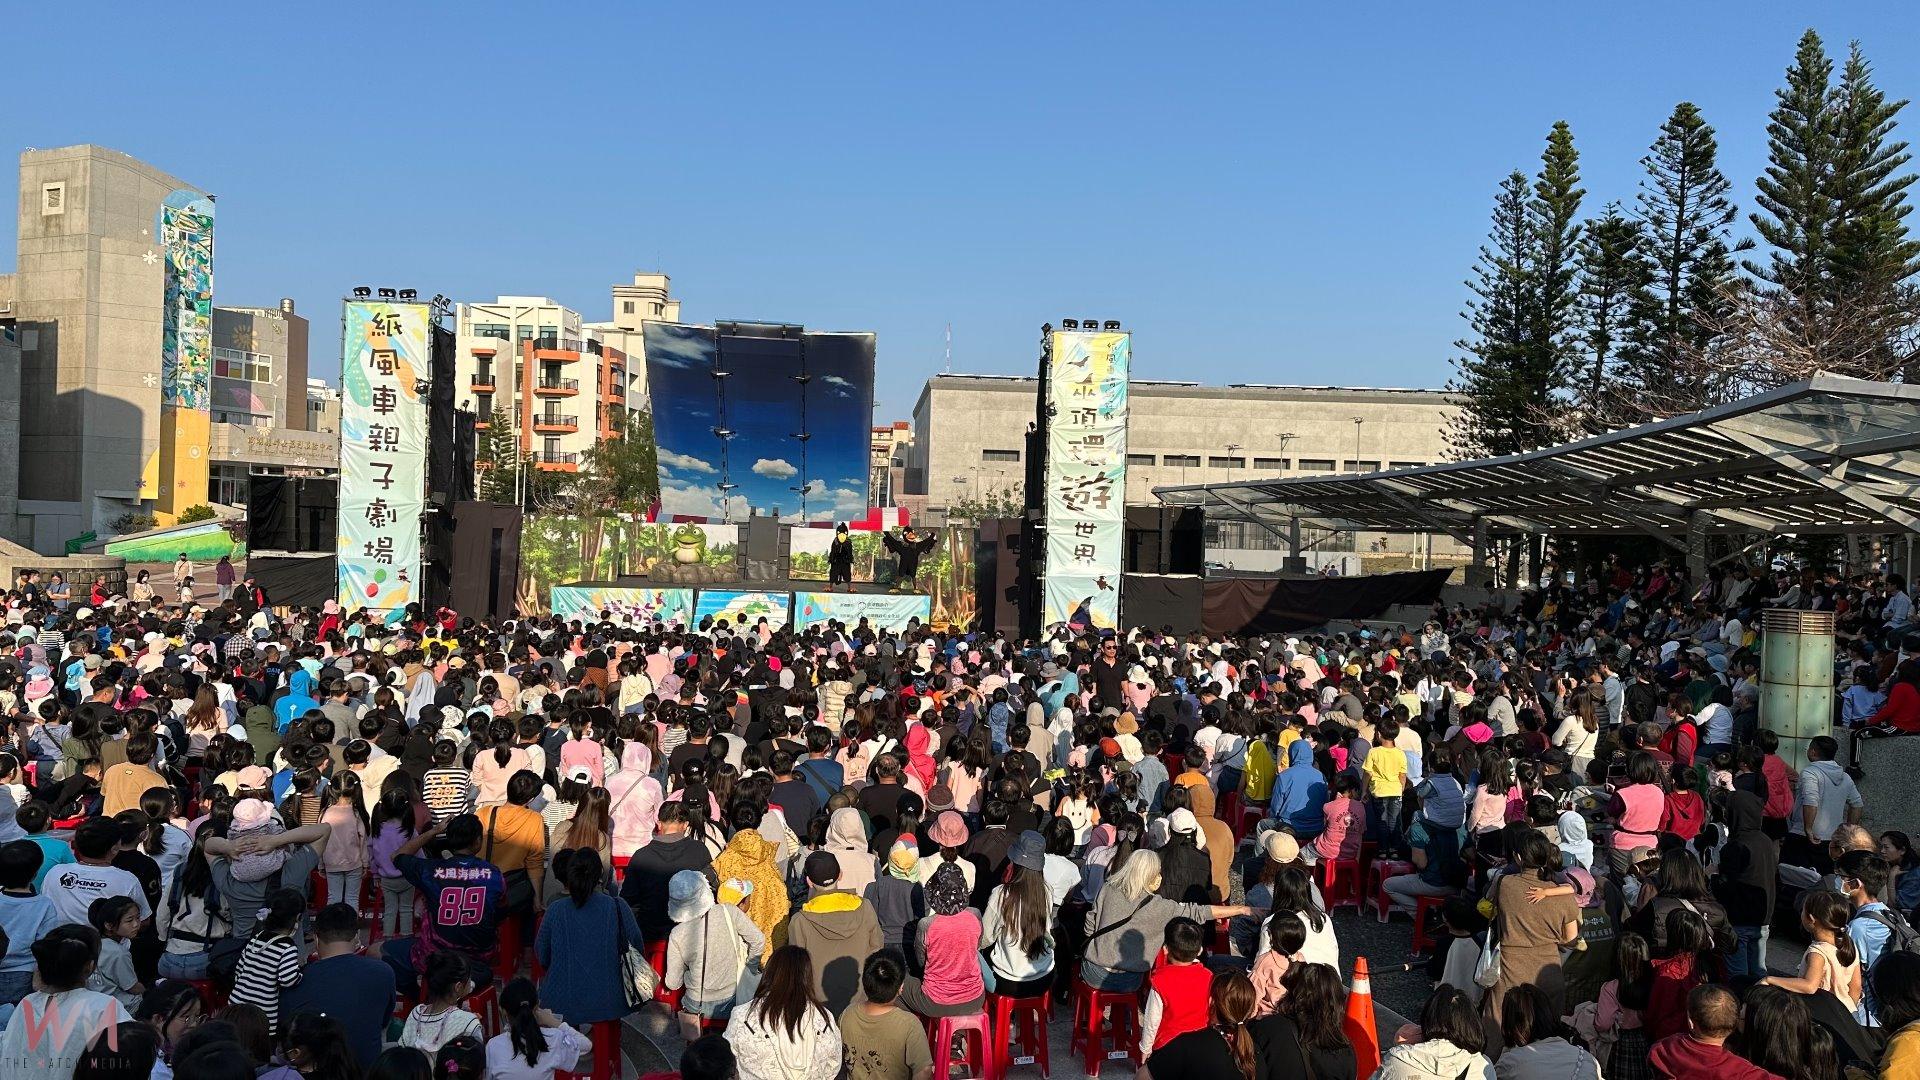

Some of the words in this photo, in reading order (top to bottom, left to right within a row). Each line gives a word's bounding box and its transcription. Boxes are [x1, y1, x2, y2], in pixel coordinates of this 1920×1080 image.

[363, 312, 403, 565] 紙風車親子劇場
[437, 886, 487, 926] 89
